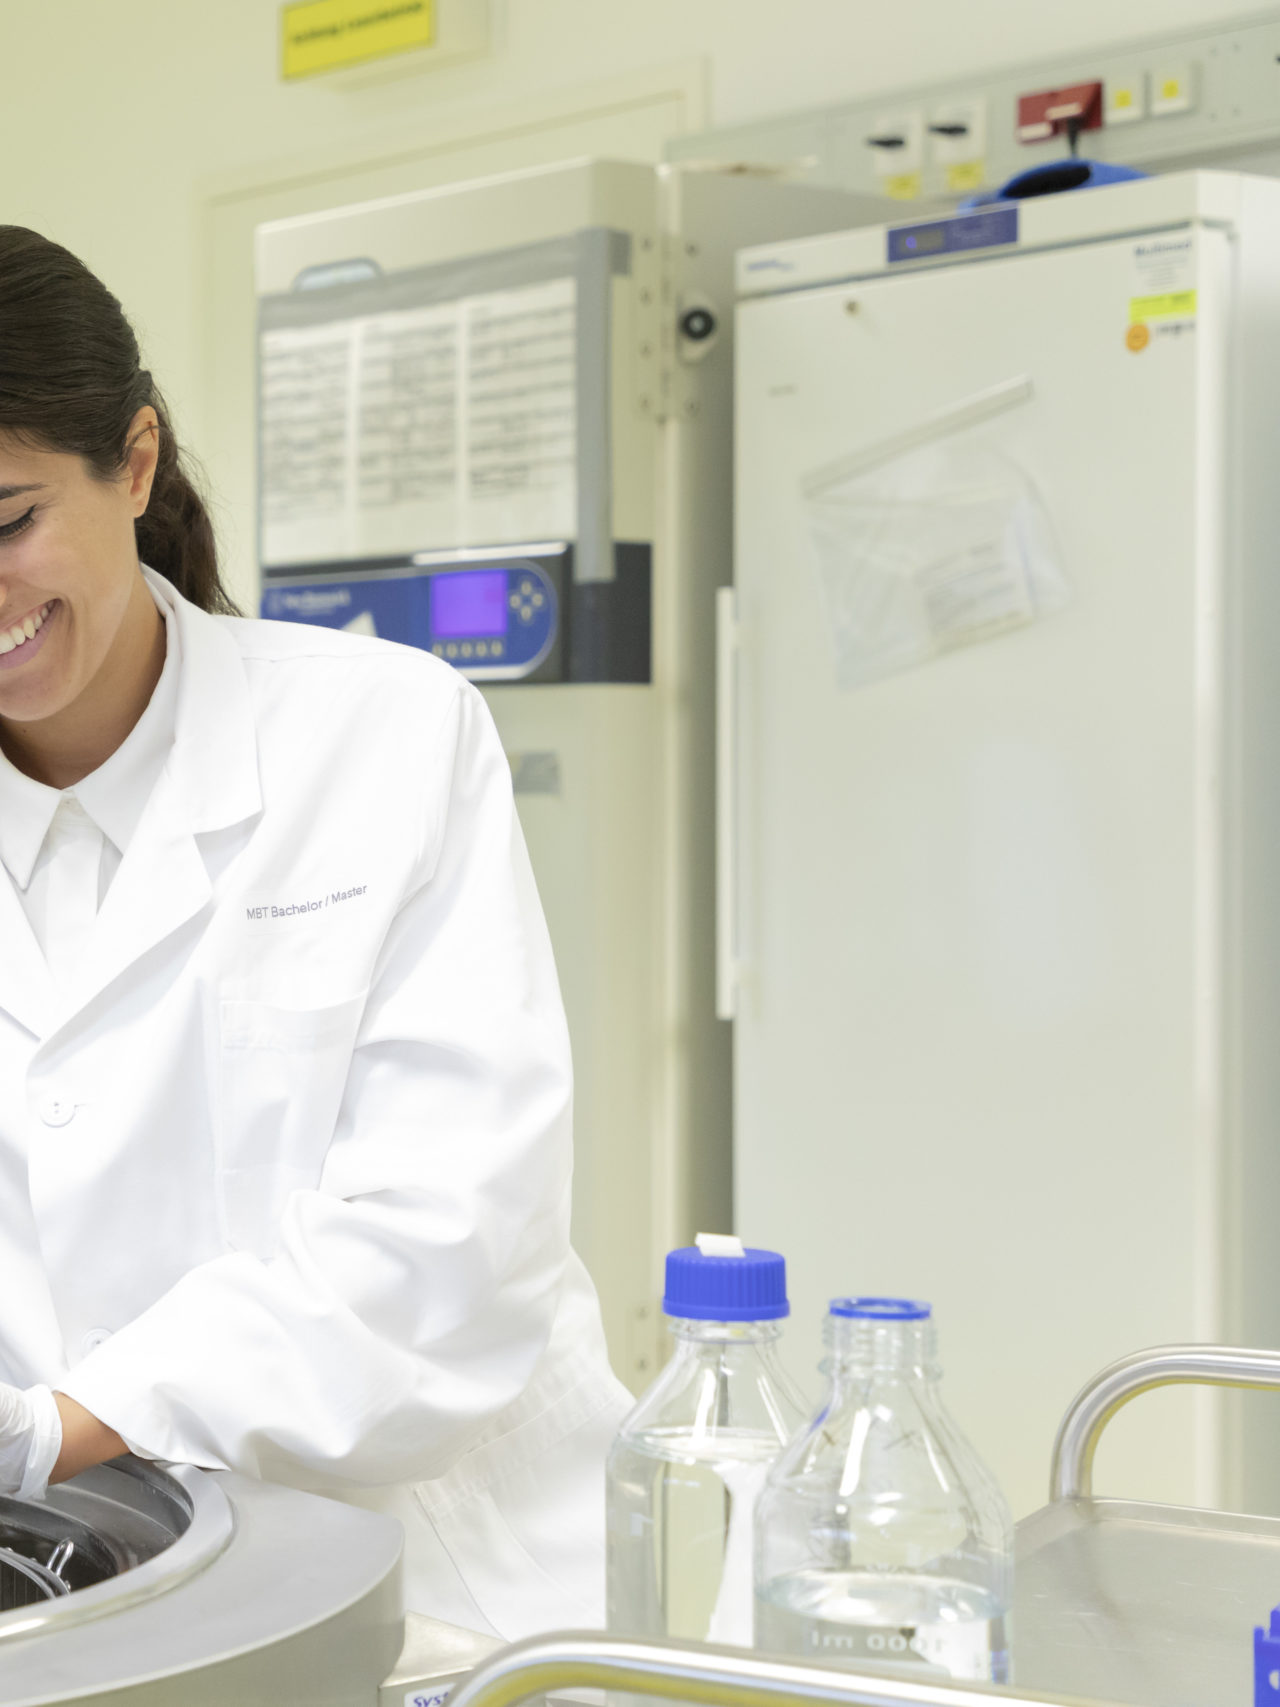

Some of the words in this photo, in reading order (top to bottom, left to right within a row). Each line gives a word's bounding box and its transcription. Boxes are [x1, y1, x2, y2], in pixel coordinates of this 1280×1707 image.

[246, 906, 269, 920] MBT
[271, 900, 323, 918] Bachelor
[331, 884, 368, 904] Master
